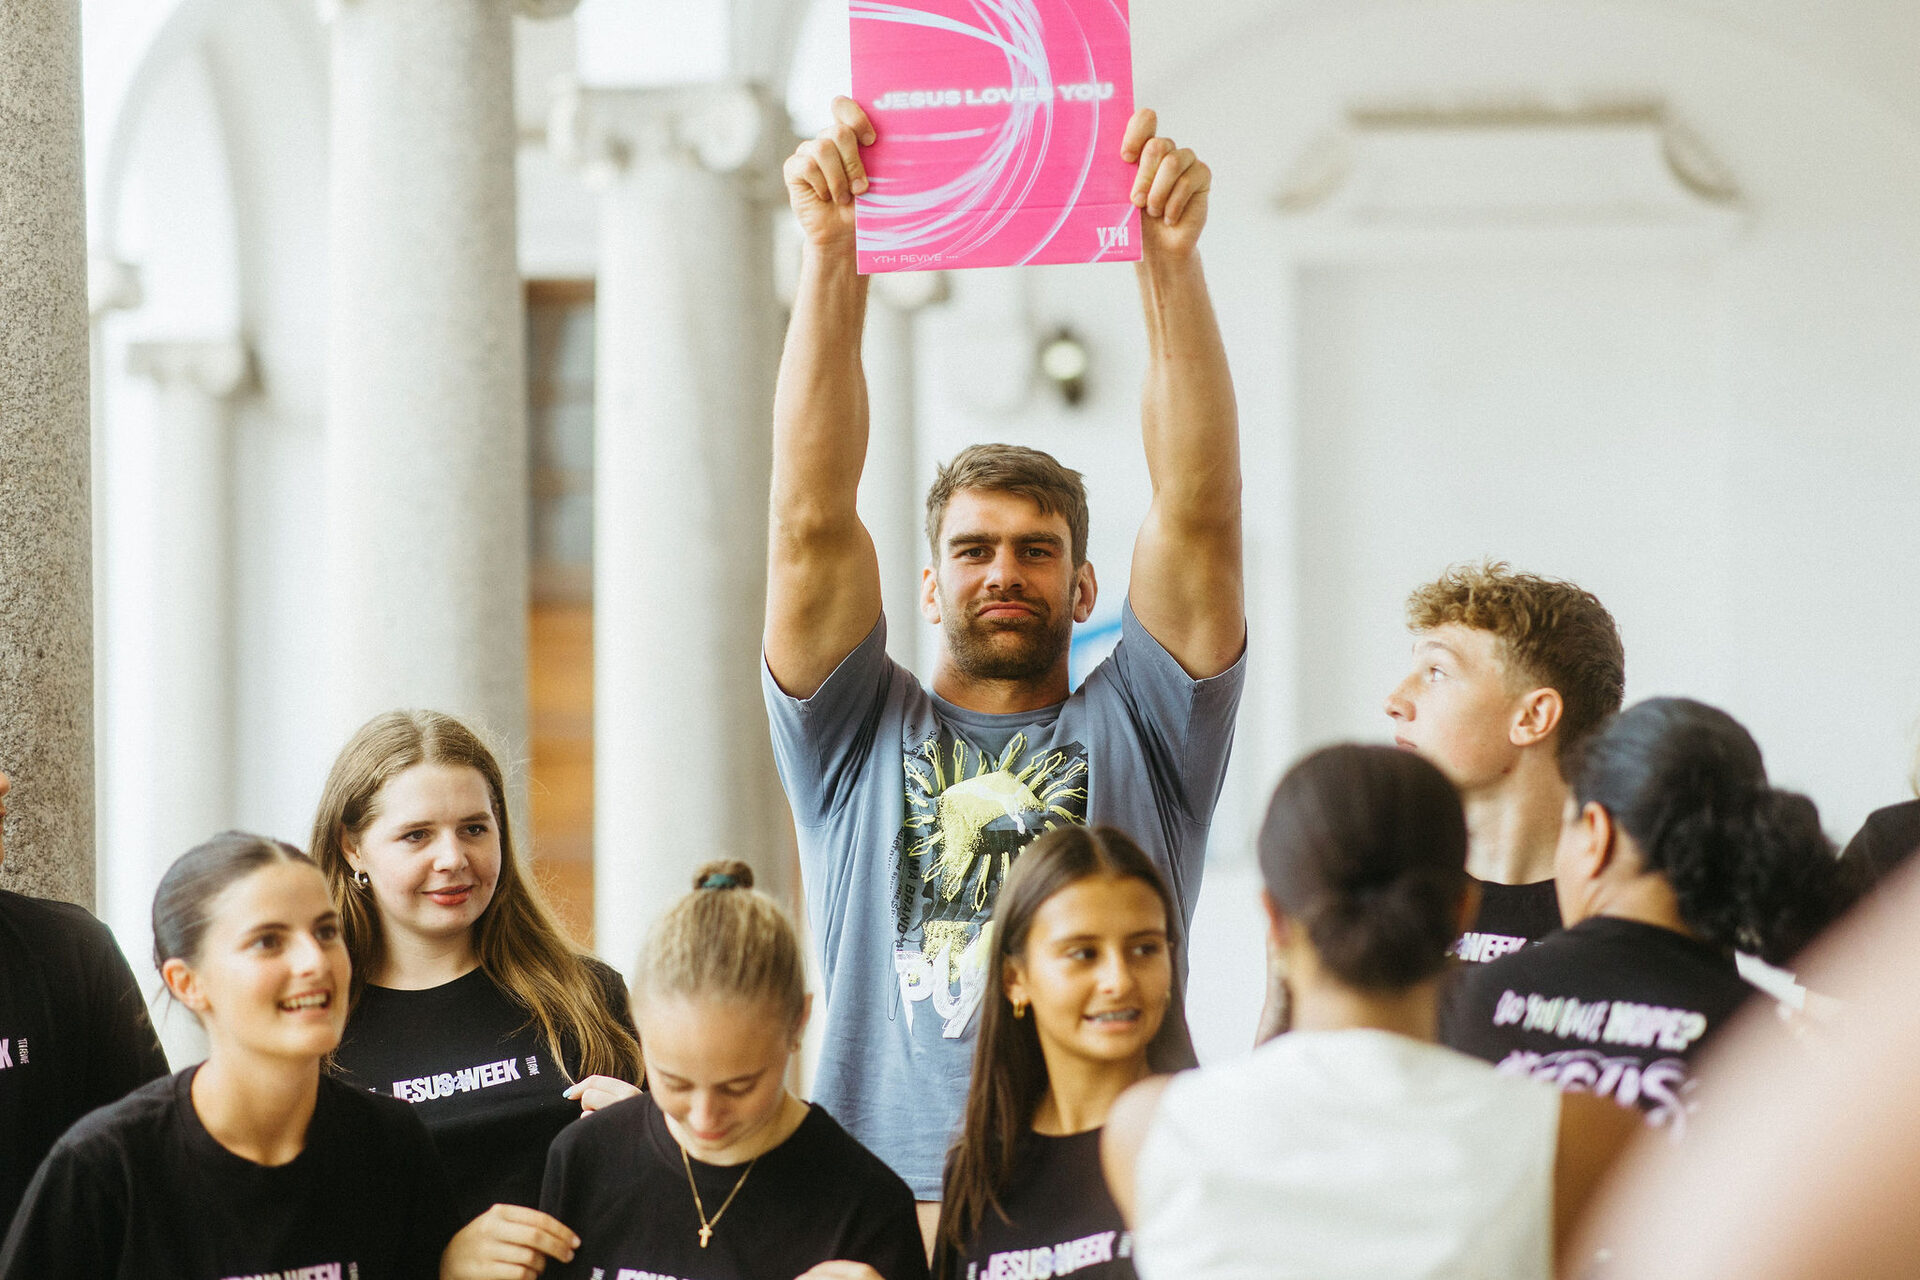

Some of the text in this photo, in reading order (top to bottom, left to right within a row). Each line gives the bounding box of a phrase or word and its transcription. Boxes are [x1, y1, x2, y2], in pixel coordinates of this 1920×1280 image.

[873, 82, 1115, 110] JESUS LOVES YOU
[1096, 226, 1129, 248] YTH
[872, 255, 896, 264] YTH
[900, 254, 942, 263] REVIVE
[896, 883, 916, 935] BRAND
[456, 1057, 522, 1093] WEEK
[1052, 1230, 1117, 1277] WEEK
